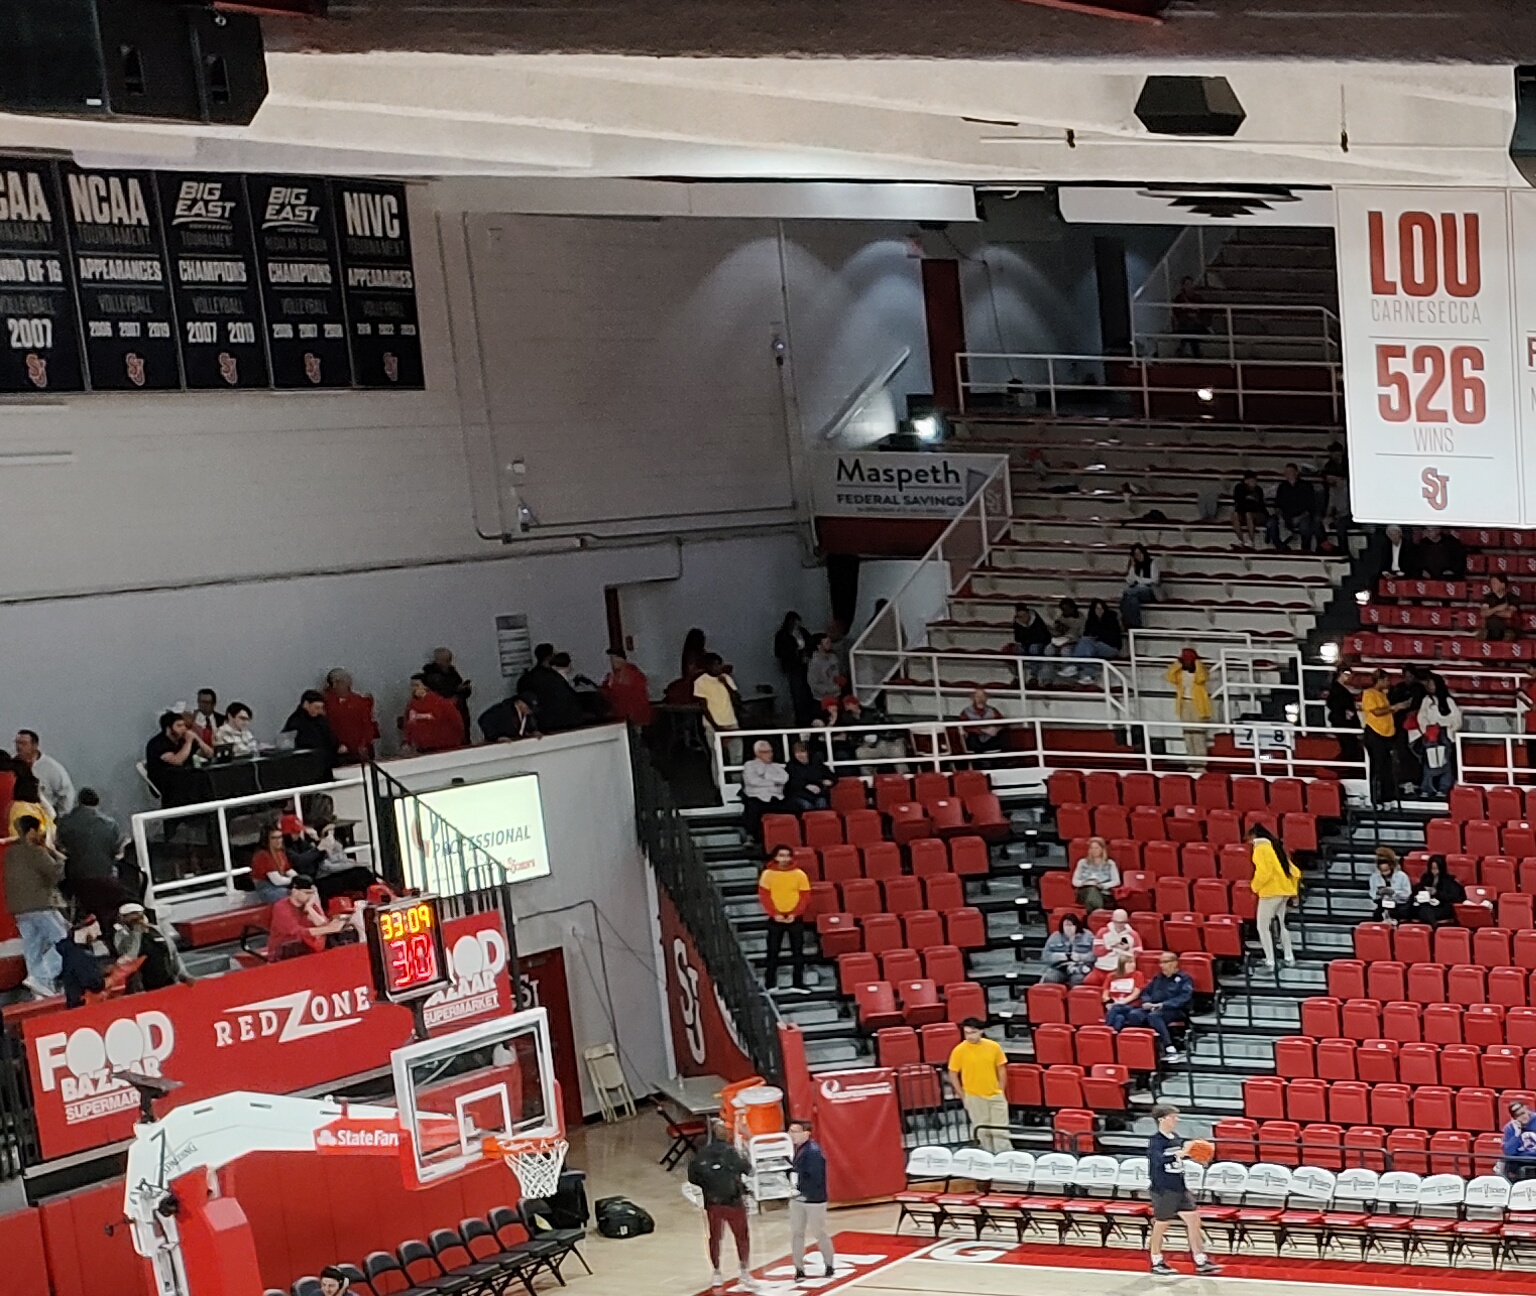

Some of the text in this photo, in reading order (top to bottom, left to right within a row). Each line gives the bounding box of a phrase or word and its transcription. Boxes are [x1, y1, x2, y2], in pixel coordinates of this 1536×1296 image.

[68, 173, 150, 226] NCAA
[179, 181, 222, 201] BIG
[268, 186, 308, 205] BIG
[174, 201, 236, 219] EAST
[264, 205, 321, 223] EAST
[343, 191, 400, 238] NIVC
[1367, 210, 1482, 299] LOU
[79, 257, 162, 281] APPEARANCES
[178, 260, 247, 283] CHAMPIONS
[267, 262, 332, 285] CHAMPIONS
[1371, 298, 1482, 326] CARNESECCA
[7, 317, 53, 349] 2007
[186, 321, 218, 344] 2007
[1374, 343, 1486, 425] 526
[1413, 427, 1455, 453] WINS
[837, 458, 960, 492] Maspeth
[837, 493, 965, 508] FEDERAL SAVINGS
[1243, 728, 1285, 743] 7 8
[380, 904, 432, 941] 33:09
[390, 933, 434, 988] 30
[35, 1010, 175, 1092] FOOD
[65, 1091, 141, 1122] SUPERMAR
